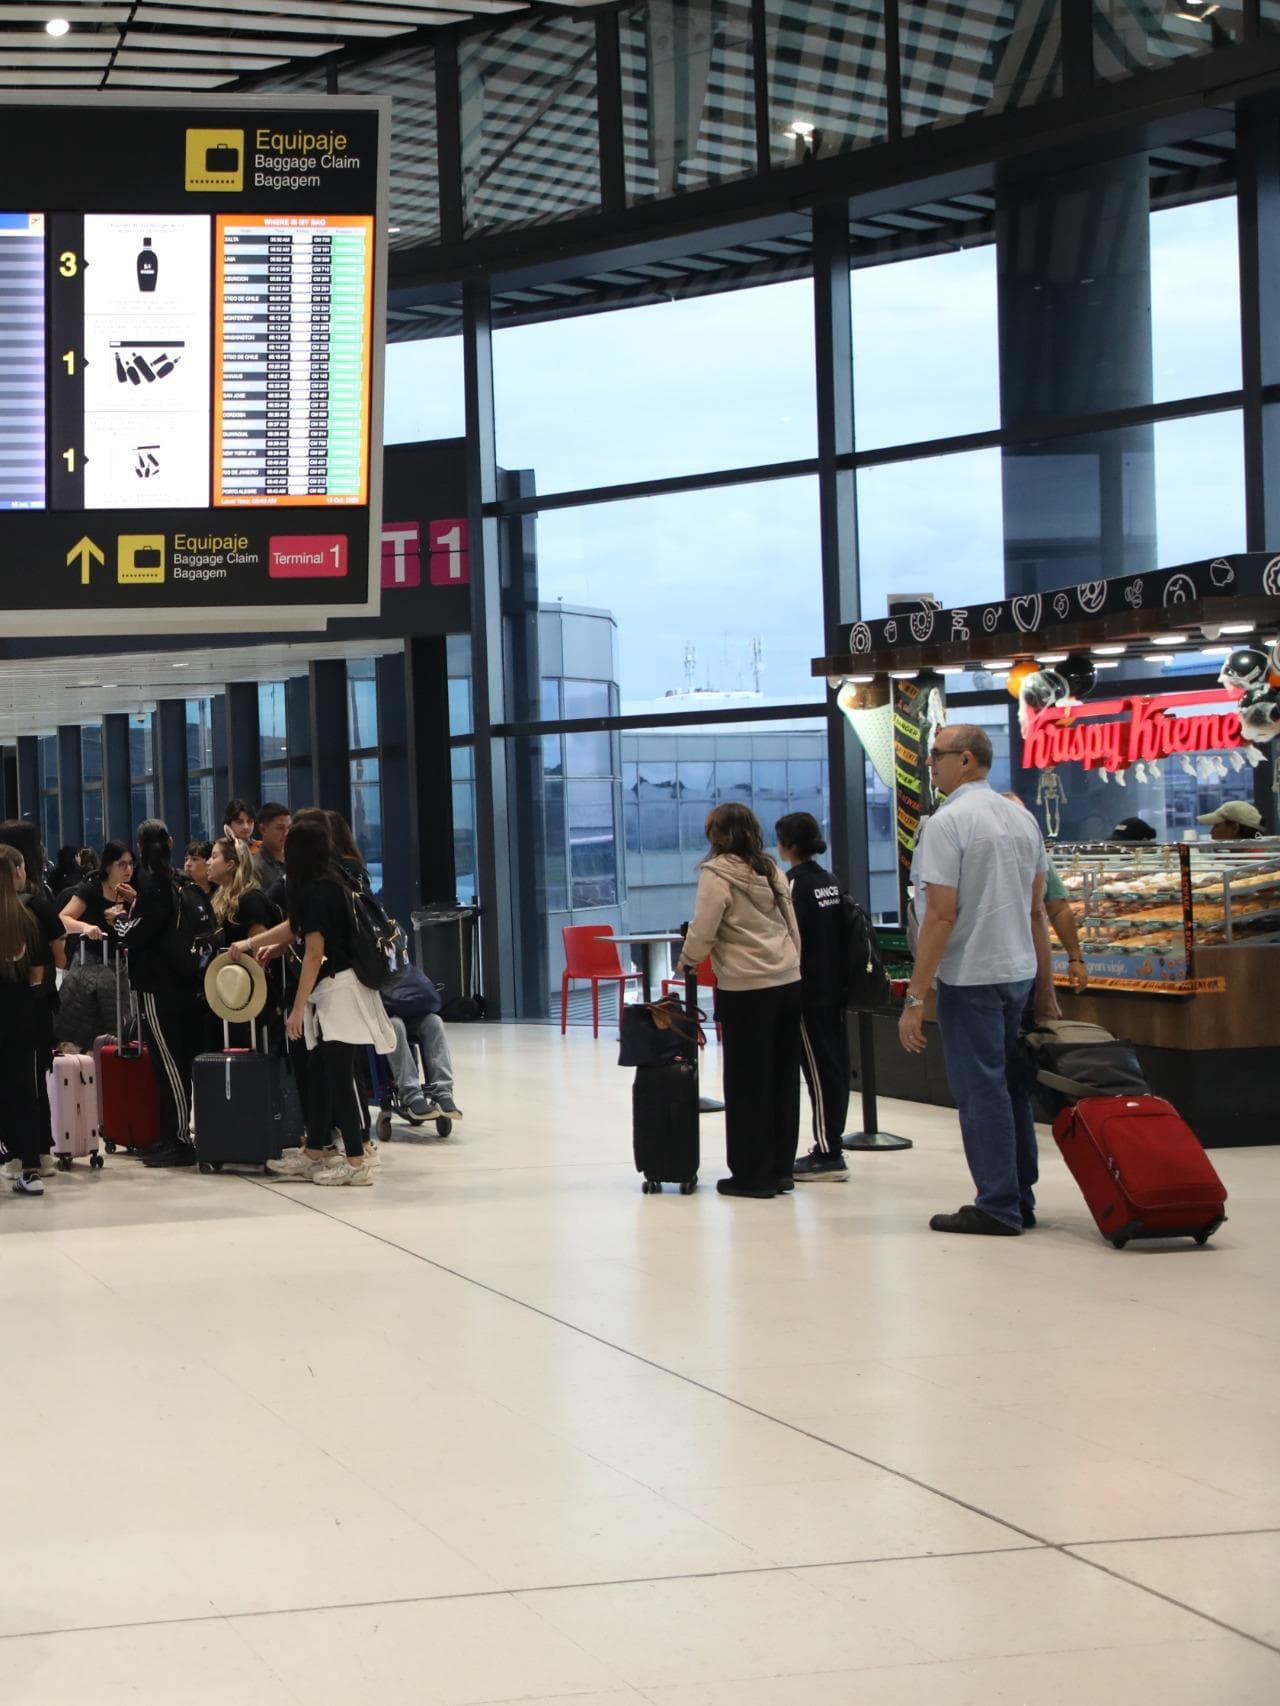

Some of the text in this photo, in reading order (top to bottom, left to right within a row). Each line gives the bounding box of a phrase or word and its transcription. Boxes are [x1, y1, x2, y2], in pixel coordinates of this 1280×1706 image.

[256, 130, 347, 154] Equipaje
[255, 154, 360, 169] Baggage Claim
[254, 173, 320, 190] Bagagem
[59, 252, 77, 277] 3
[63, 351, 74, 375] 1
[63, 448, 74, 472] 1
[174, 535, 248, 553] Equipaje
[381, 526, 461, 582] T 1
[173, 552, 258, 567] Baggage Claim
[272, 545, 340, 568] Terminal 1
[173, 567, 227, 581] Bagagem
[1022, 689, 1245, 773] Krispy Kreme
